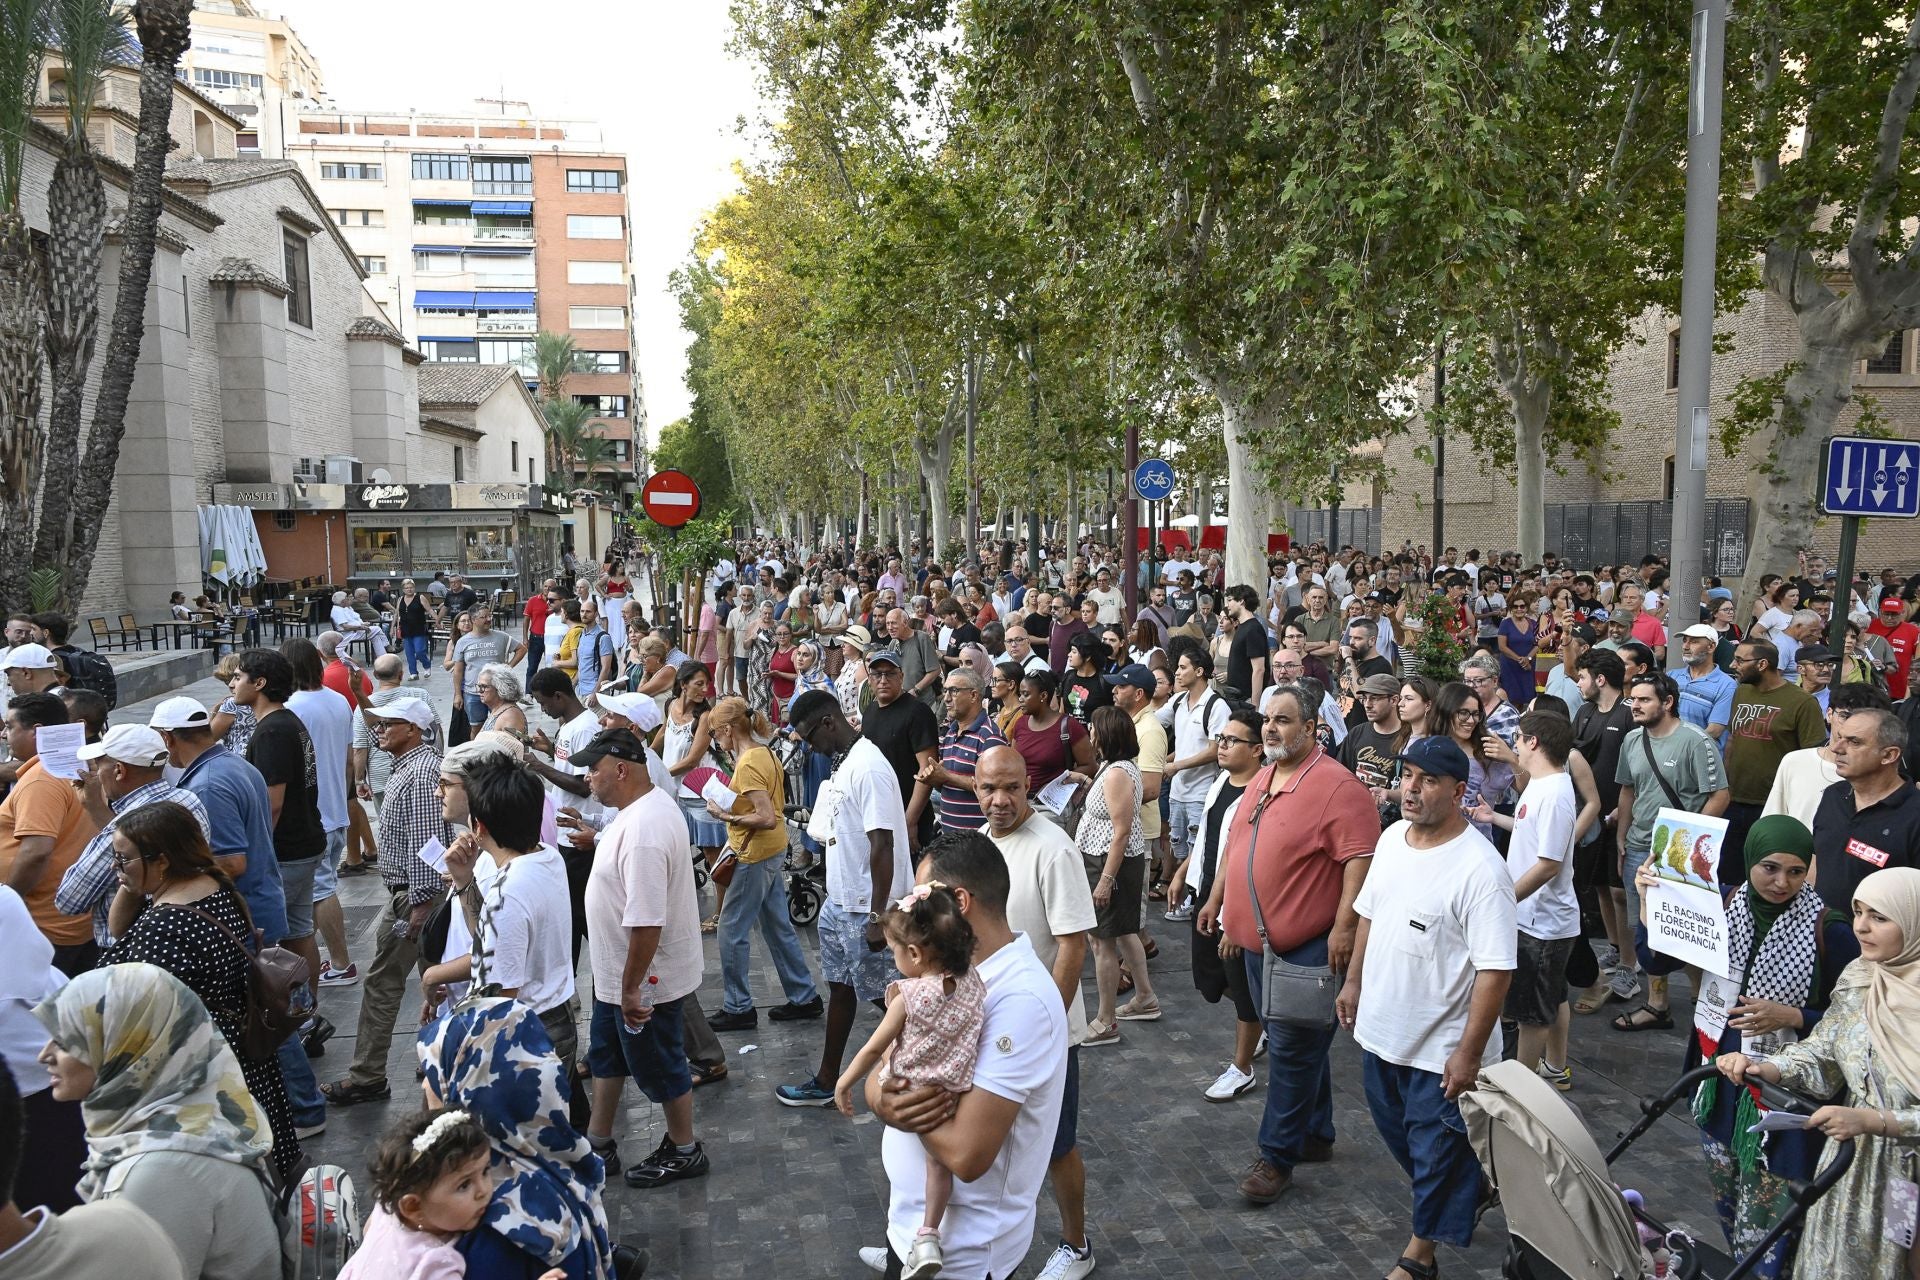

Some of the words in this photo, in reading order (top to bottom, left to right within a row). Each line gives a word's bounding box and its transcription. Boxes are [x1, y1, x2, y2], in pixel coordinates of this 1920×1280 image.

[237, 491, 278, 501] AMSTEL
[484, 491, 523, 501] AMSTEL
[1654, 911, 1696, 932] FLORECE
[1697, 924, 1709, 937] DE
[1711, 929, 1721, 942] LA
[1662, 901, 1673, 913] EL
[1674, 905, 1715, 927] RACISMO
[1660, 924, 1717, 952] IGNORANCIA
